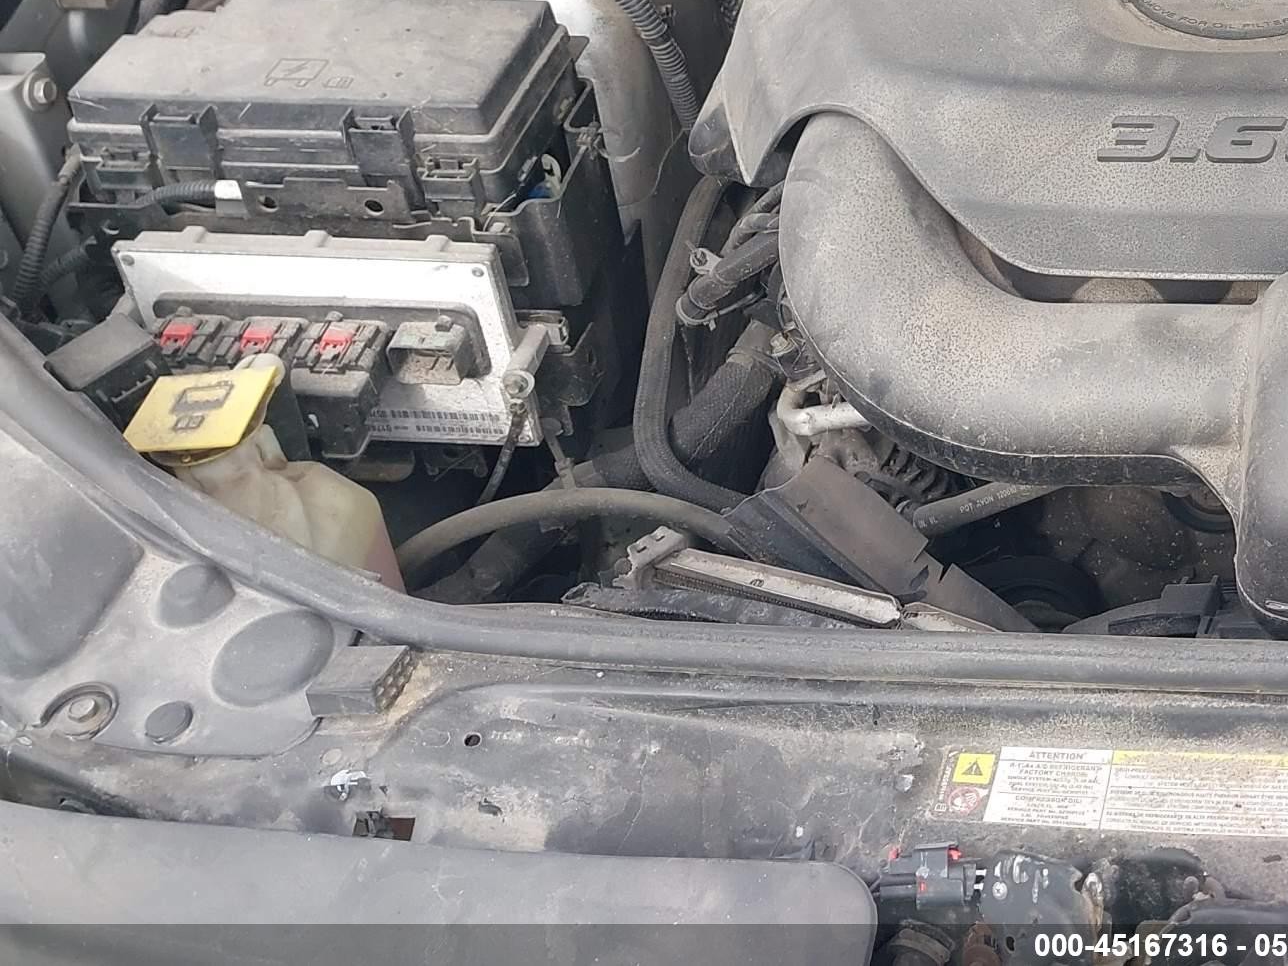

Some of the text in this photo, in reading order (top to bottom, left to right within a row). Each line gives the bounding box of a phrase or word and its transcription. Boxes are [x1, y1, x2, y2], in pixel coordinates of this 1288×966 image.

[1178, 16, 1208, 27] FOR
[1212, 22, 1236, 30] OIL
[1028, 751, 1084, 761] ATTENTION
